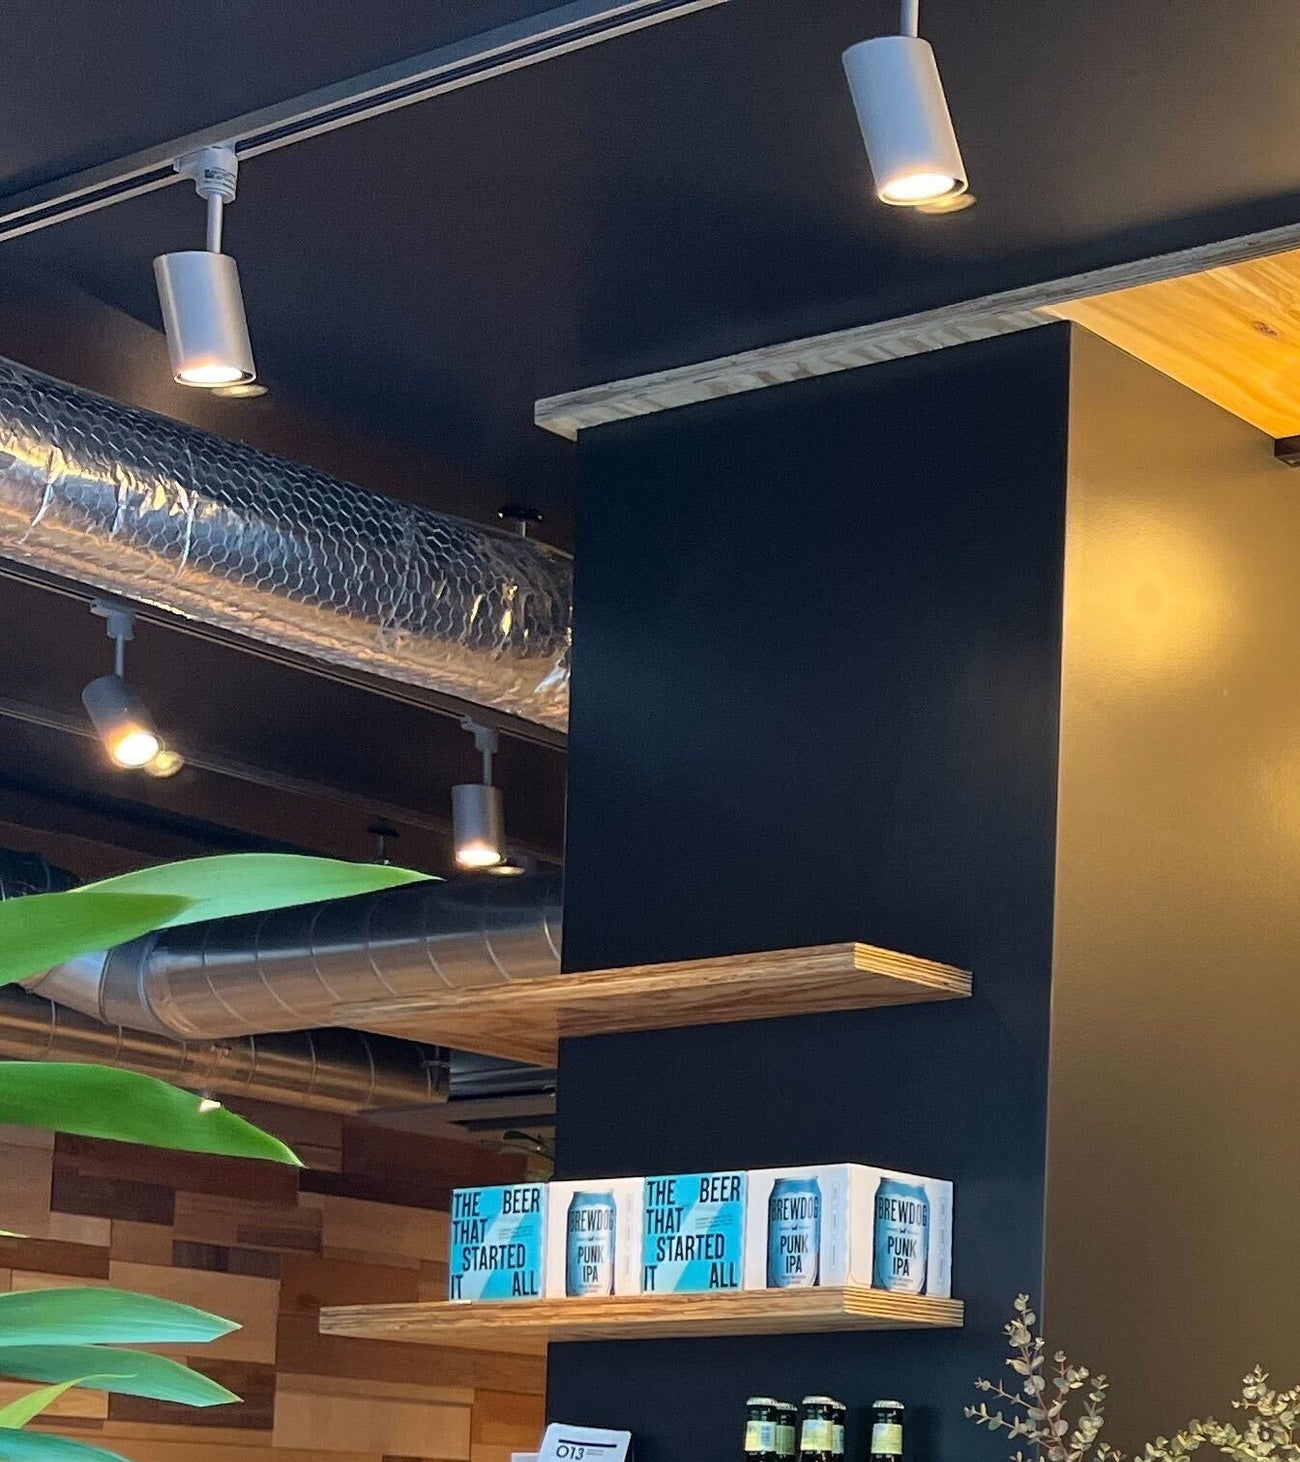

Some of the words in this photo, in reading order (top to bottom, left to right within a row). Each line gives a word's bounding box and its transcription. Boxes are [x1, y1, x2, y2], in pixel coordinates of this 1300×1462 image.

[454, 1192, 481, 1217] THE
[503, 1188, 540, 1214] BEER
[647, 1180, 676, 1205] THE
[700, 1176, 740, 1202] BEER
[569, 1209, 614, 1232] BREWDOG
[646, 1208, 684, 1234] THAT
[771, 1197, 819, 1221] BREWDOG
[878, 1198, 927, 1227] BREWDOG
[453, 1219, 487, 1244] THAT
[577, 1246, 604, 1264] PUNK
[657, 1234, 725, 1261] STARTED
[780, 1235, 808, 1254] PUNK
[887, 1236, 916, 1258] PUNK
[462, 1244, 525, 1271] STARTED
[786, 1256, 802, 1273] IPA
[893, 1258, 909, 1276] IPA
[451, 1275, 463, 1299] IT
[512, 1271, 538, 1296] ALL
[583, 1266, 598, 1283] IPA
[644, 1266, 657, 1291] IT
[710, 1262, 738, 1288] ALL
